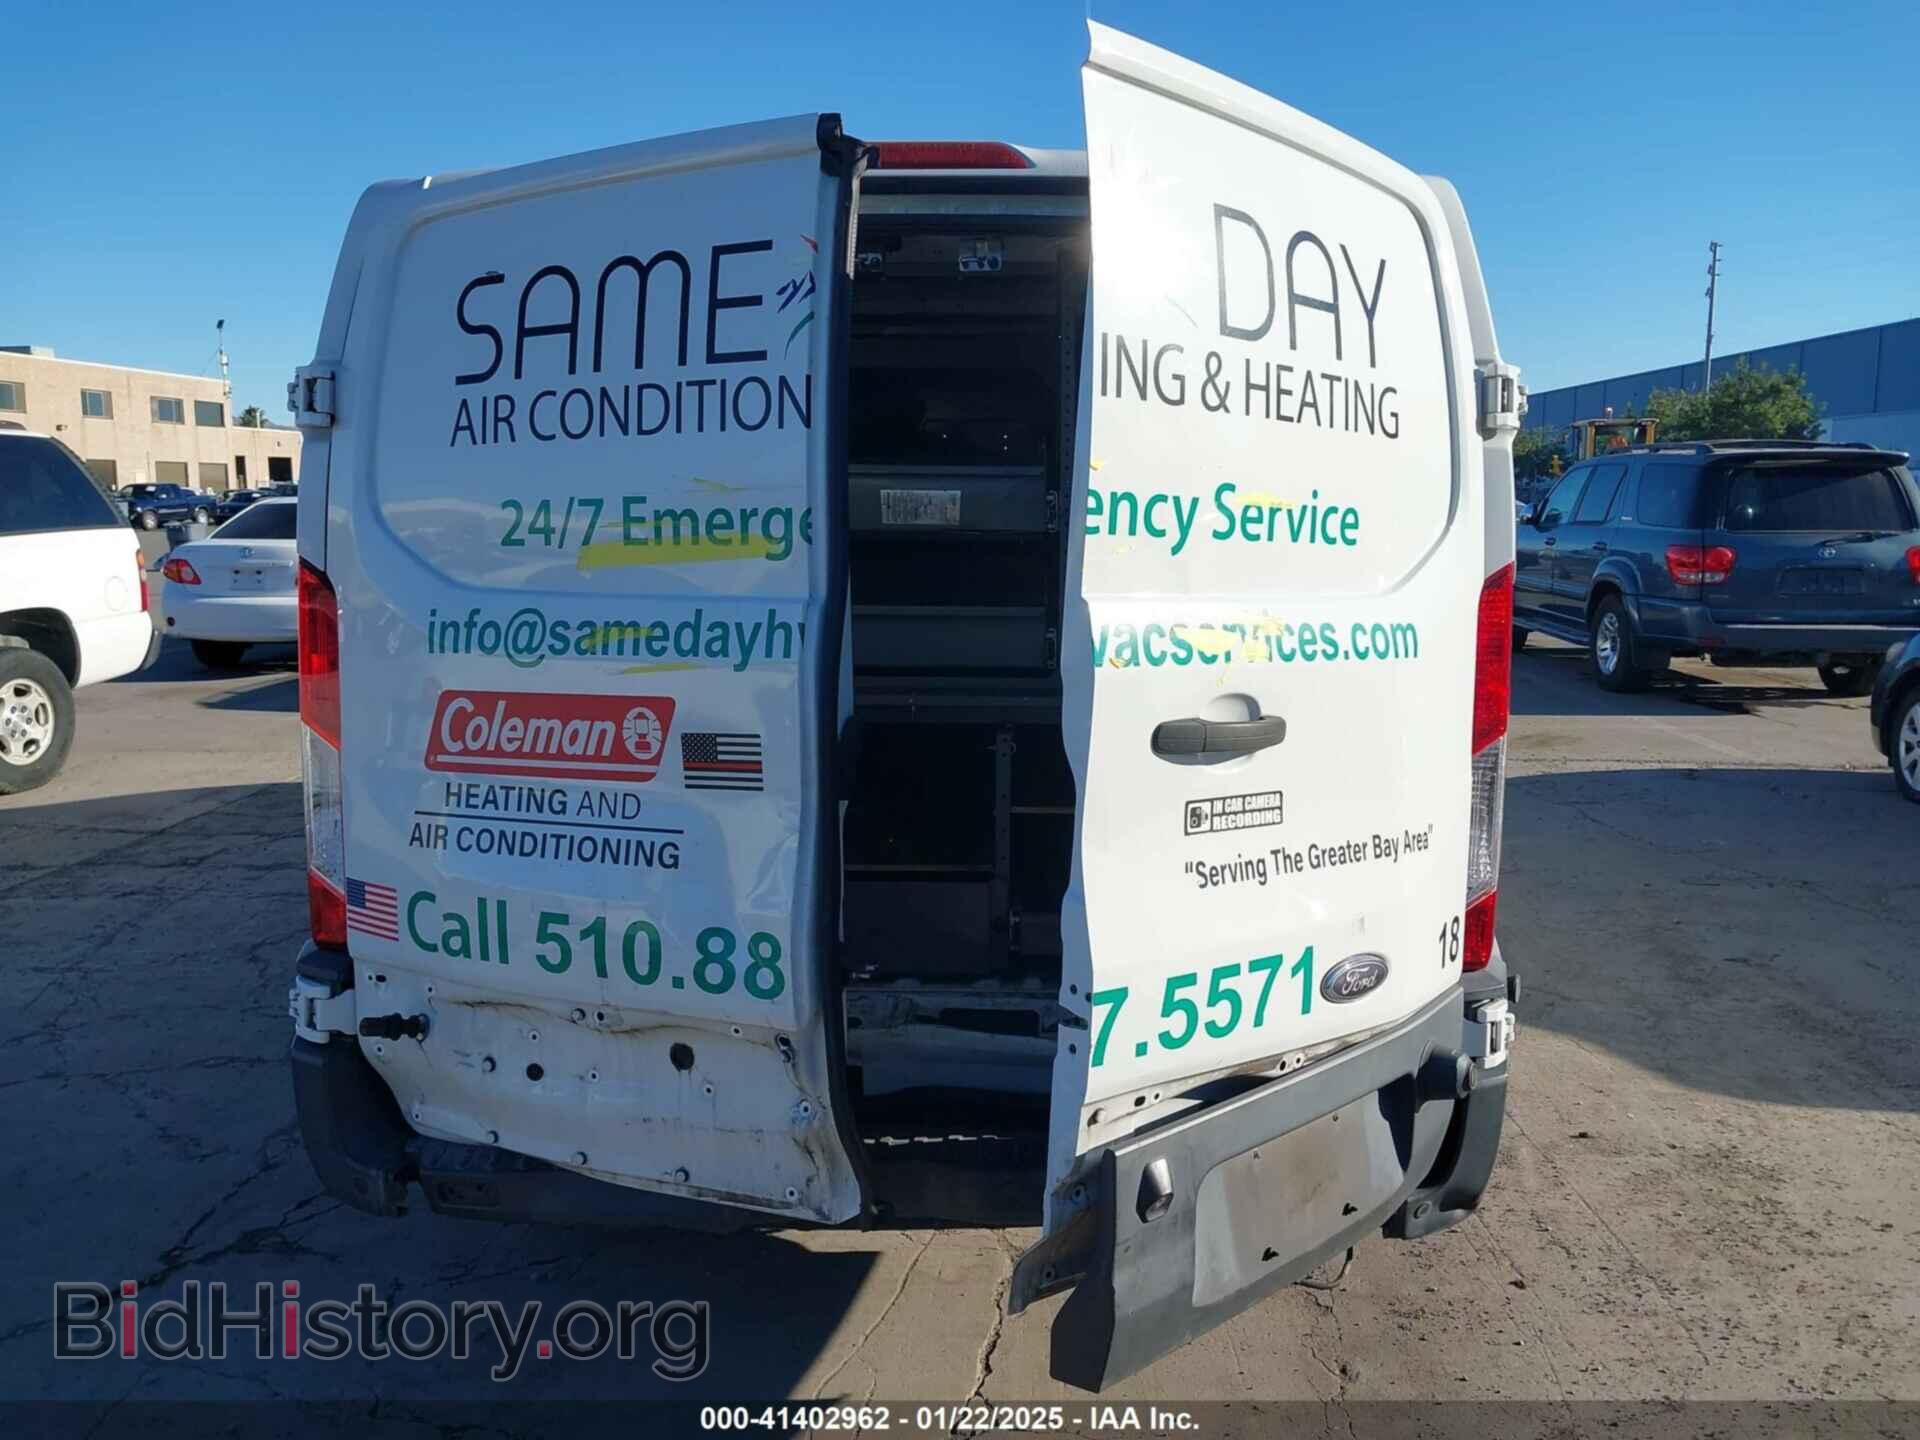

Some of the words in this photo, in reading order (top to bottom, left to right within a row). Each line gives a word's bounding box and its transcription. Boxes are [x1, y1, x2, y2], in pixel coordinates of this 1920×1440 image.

[455, 239, 773, 386] SAME
[1213, 202, 1387, 369] DAY
[450, 393, 516, 447] AIR
[529, 373, 812, 442] CONDITION
[1100, 331, 1186, 407] ING
[1200, 350, 1231, 414] &
[1244, 357, 1399, 440] HEATING
[500, 496, 604, 549] 24/7
[1212, 482, 1360, 547] Service
[427, 607, 806, 673] info@samedayh
[440, 695, 616, 758] Coleman
[445, 781, 568, 816] HEATING
[576, 790, 642, 820] AND
[1212, 799, 1224, 815] IN
[1212, 808, 1281, 831] RECORDING
[409, 821, 449, 851] AIR
[456, 826, 681, 870] CONDITIONING
[1270, 846, 1304, 876] The
[1308, 840, 1369, 870] Greater
[1372, 834, 1400, 863] Bay
[406, 890, 510, 965] Call
[535, 910, 786, 1000] 510.88
[1439, 915, 1460, 969] 18
[1091, 945, 1315, 1069] 7.5571
[1341, 963, 1379, 996] Ford
